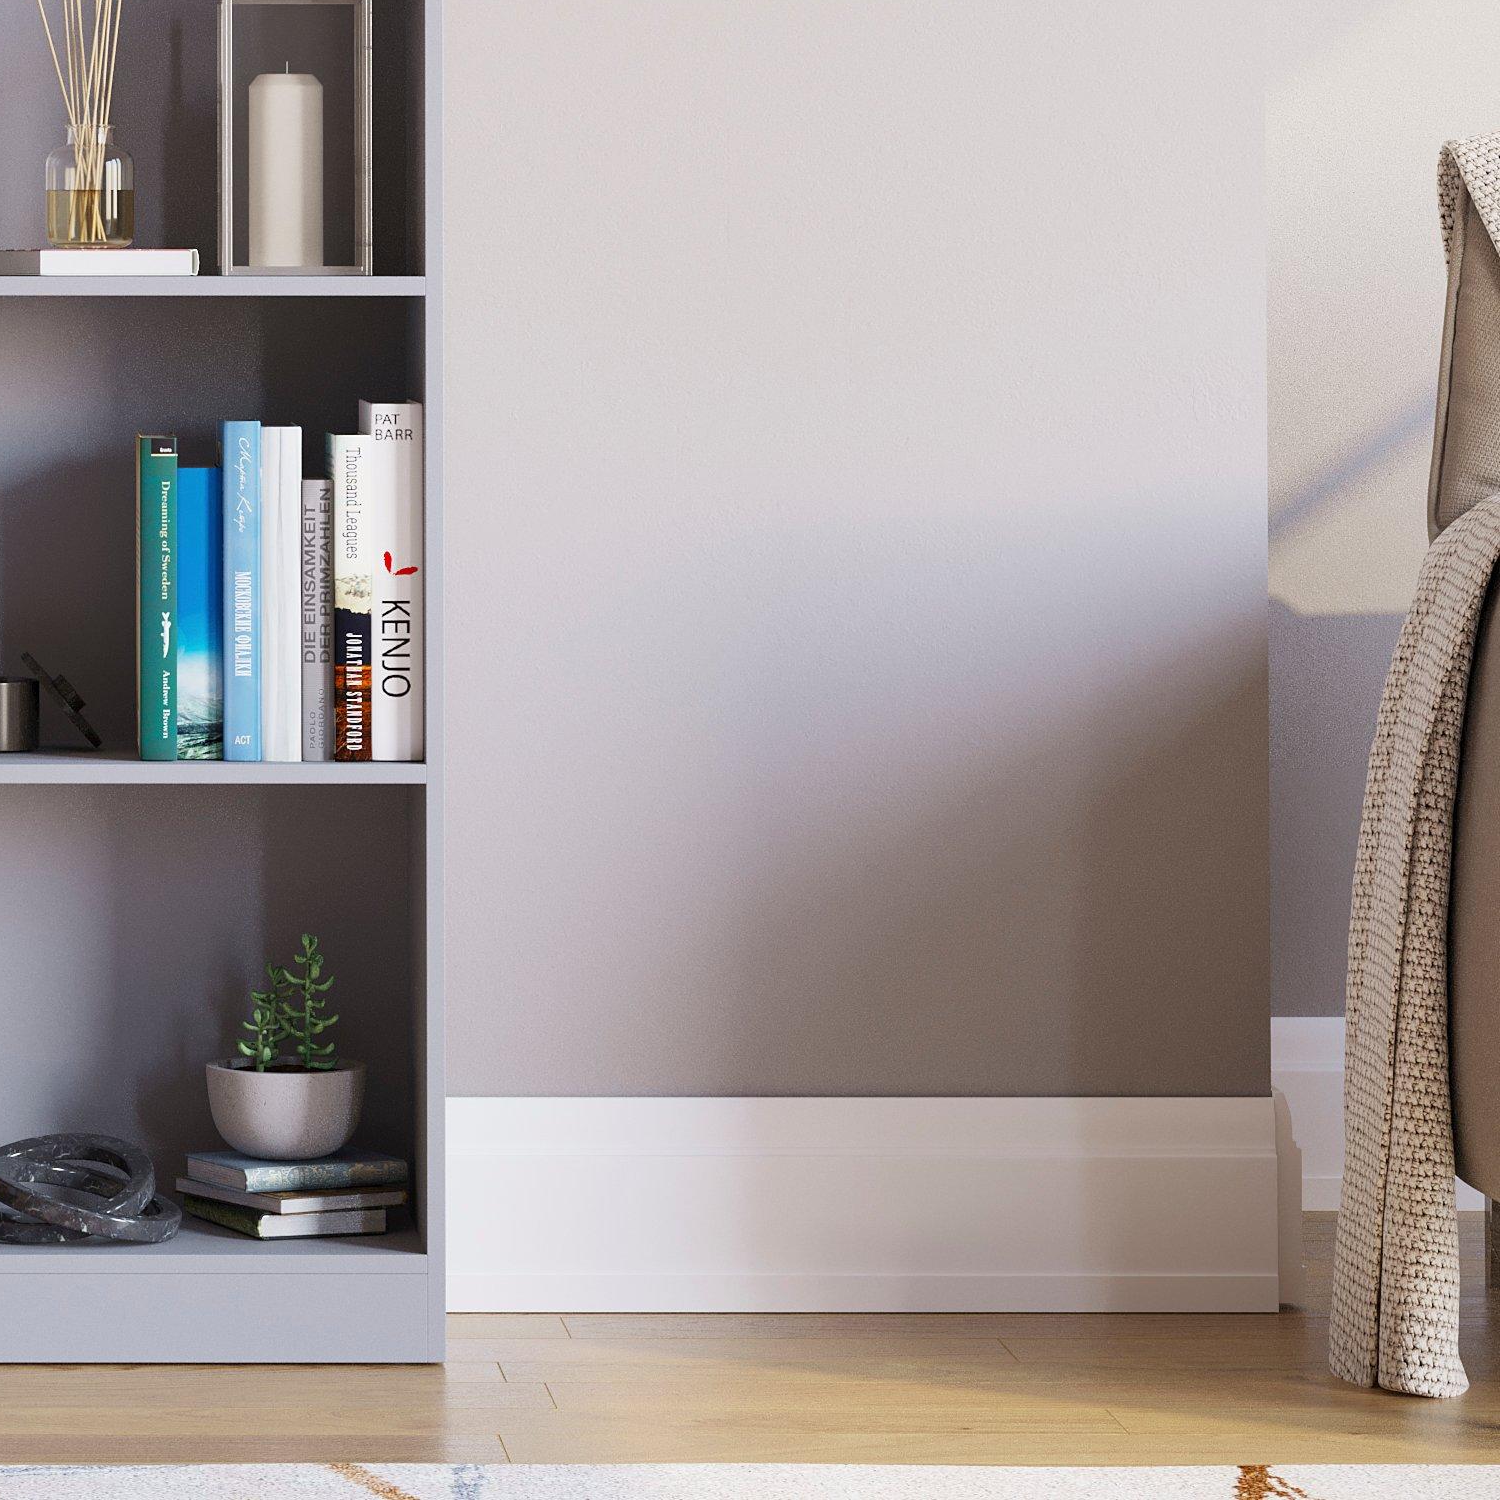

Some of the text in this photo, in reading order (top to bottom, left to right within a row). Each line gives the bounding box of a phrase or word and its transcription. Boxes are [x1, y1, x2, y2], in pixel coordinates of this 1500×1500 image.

[375, 413, 400, 425] PAT
[375, 428, 413, 441] BARR
[159, 481, 171, 600] Dreaming of Sweden
[342, 447, 362, 559] Thousand Leagues
[304, 504, 316, 664] DIE EINSAMKEIT
[319, 488, 331, 664] DER PRIMZAHLEN
[345, 632, 363, 686] JONATHAN
[382, 600, 411, 698] KENJO
[162, 670, 171, 739] Andrew Brown
